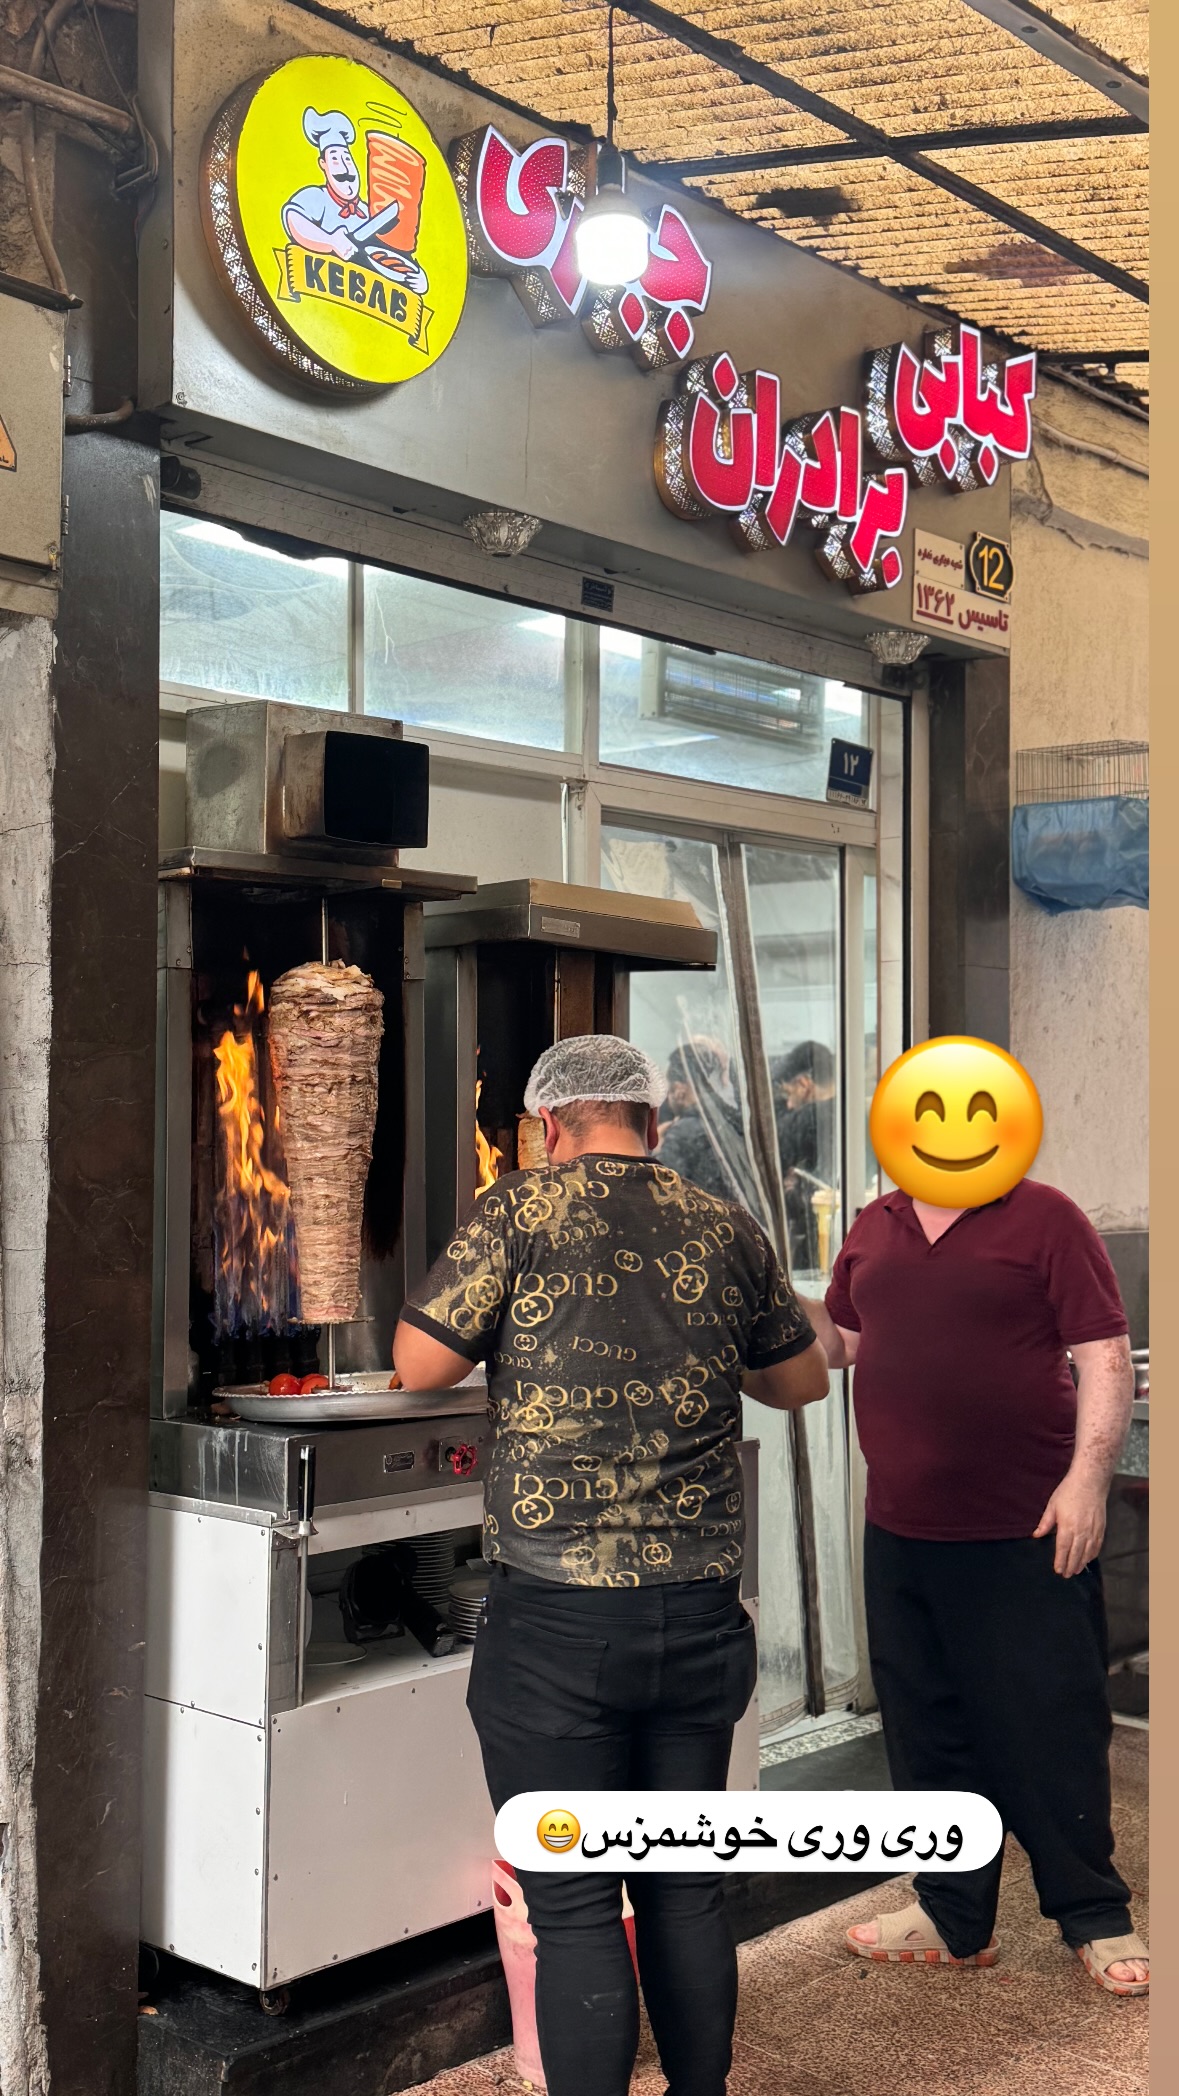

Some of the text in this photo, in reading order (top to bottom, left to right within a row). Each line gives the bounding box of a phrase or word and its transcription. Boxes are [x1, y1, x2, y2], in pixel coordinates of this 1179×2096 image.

[304, 254, 408, 323] KEBAB
[893, 324, 1037, 486] کبابی
[689, 351, 908, 589] برادران
[978, 544, 1005, 591] 12
[917, 582, 1009, 632] تاسیس ۱۳۶۲
[843, 751, 859, 777] ۱۲
[506, 1180, 610, 1207] GUCCI
[550, 1220, 610, 1251] GUCCI
[654, 1221, 735, 1279] GUCCI
[513, 1272, 618, 1297] GUCCI
[571, 1335, 637, 1362] GUCCI
[515, 1379, 618, 1409] GUCCI
[658, 1344, 739, 1406] GUCCI
[512, 1472, 618, 1500] GUCCI
